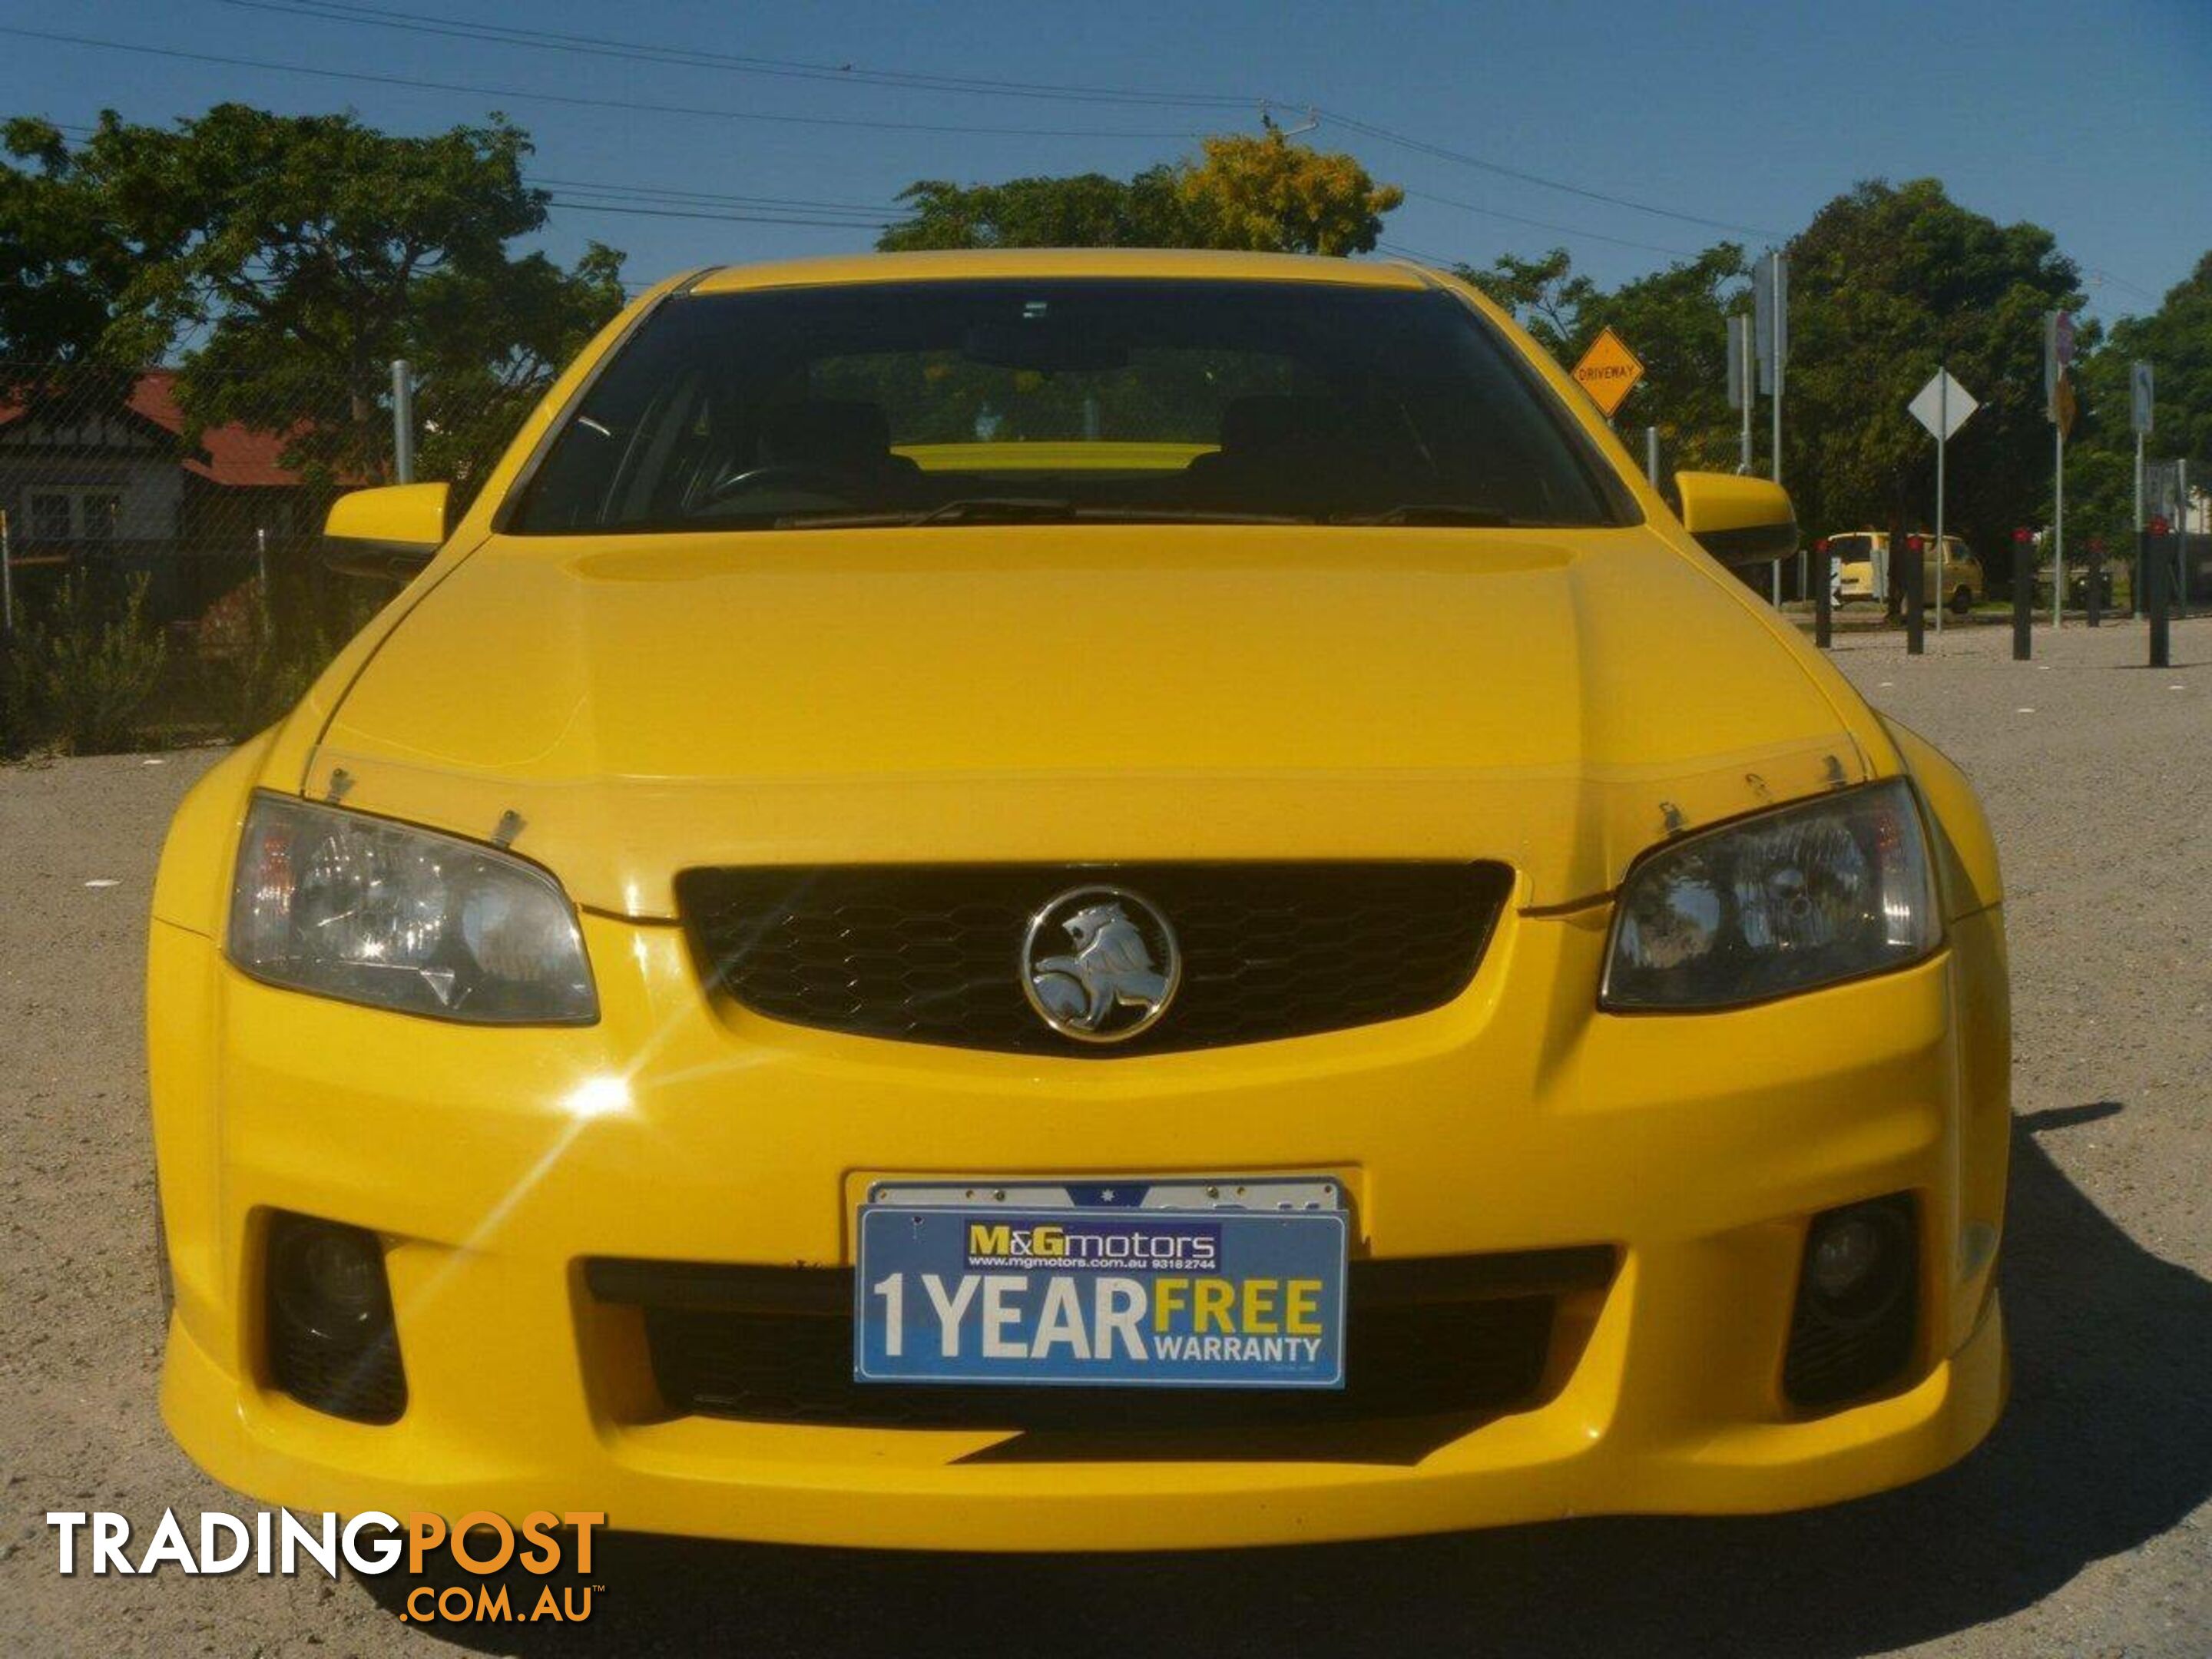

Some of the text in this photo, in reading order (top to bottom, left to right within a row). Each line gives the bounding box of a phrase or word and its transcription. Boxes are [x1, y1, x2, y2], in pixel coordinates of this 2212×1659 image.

[1579, 366, 1634, 380] DRIVEWAY
[969, 1256, 1147, 1269] www.mgmotors.com.au
[873, 1273, 1322, 1361] 1 YEAR FREE
[1154, 1336, 1321, 1362] WARRANTY
